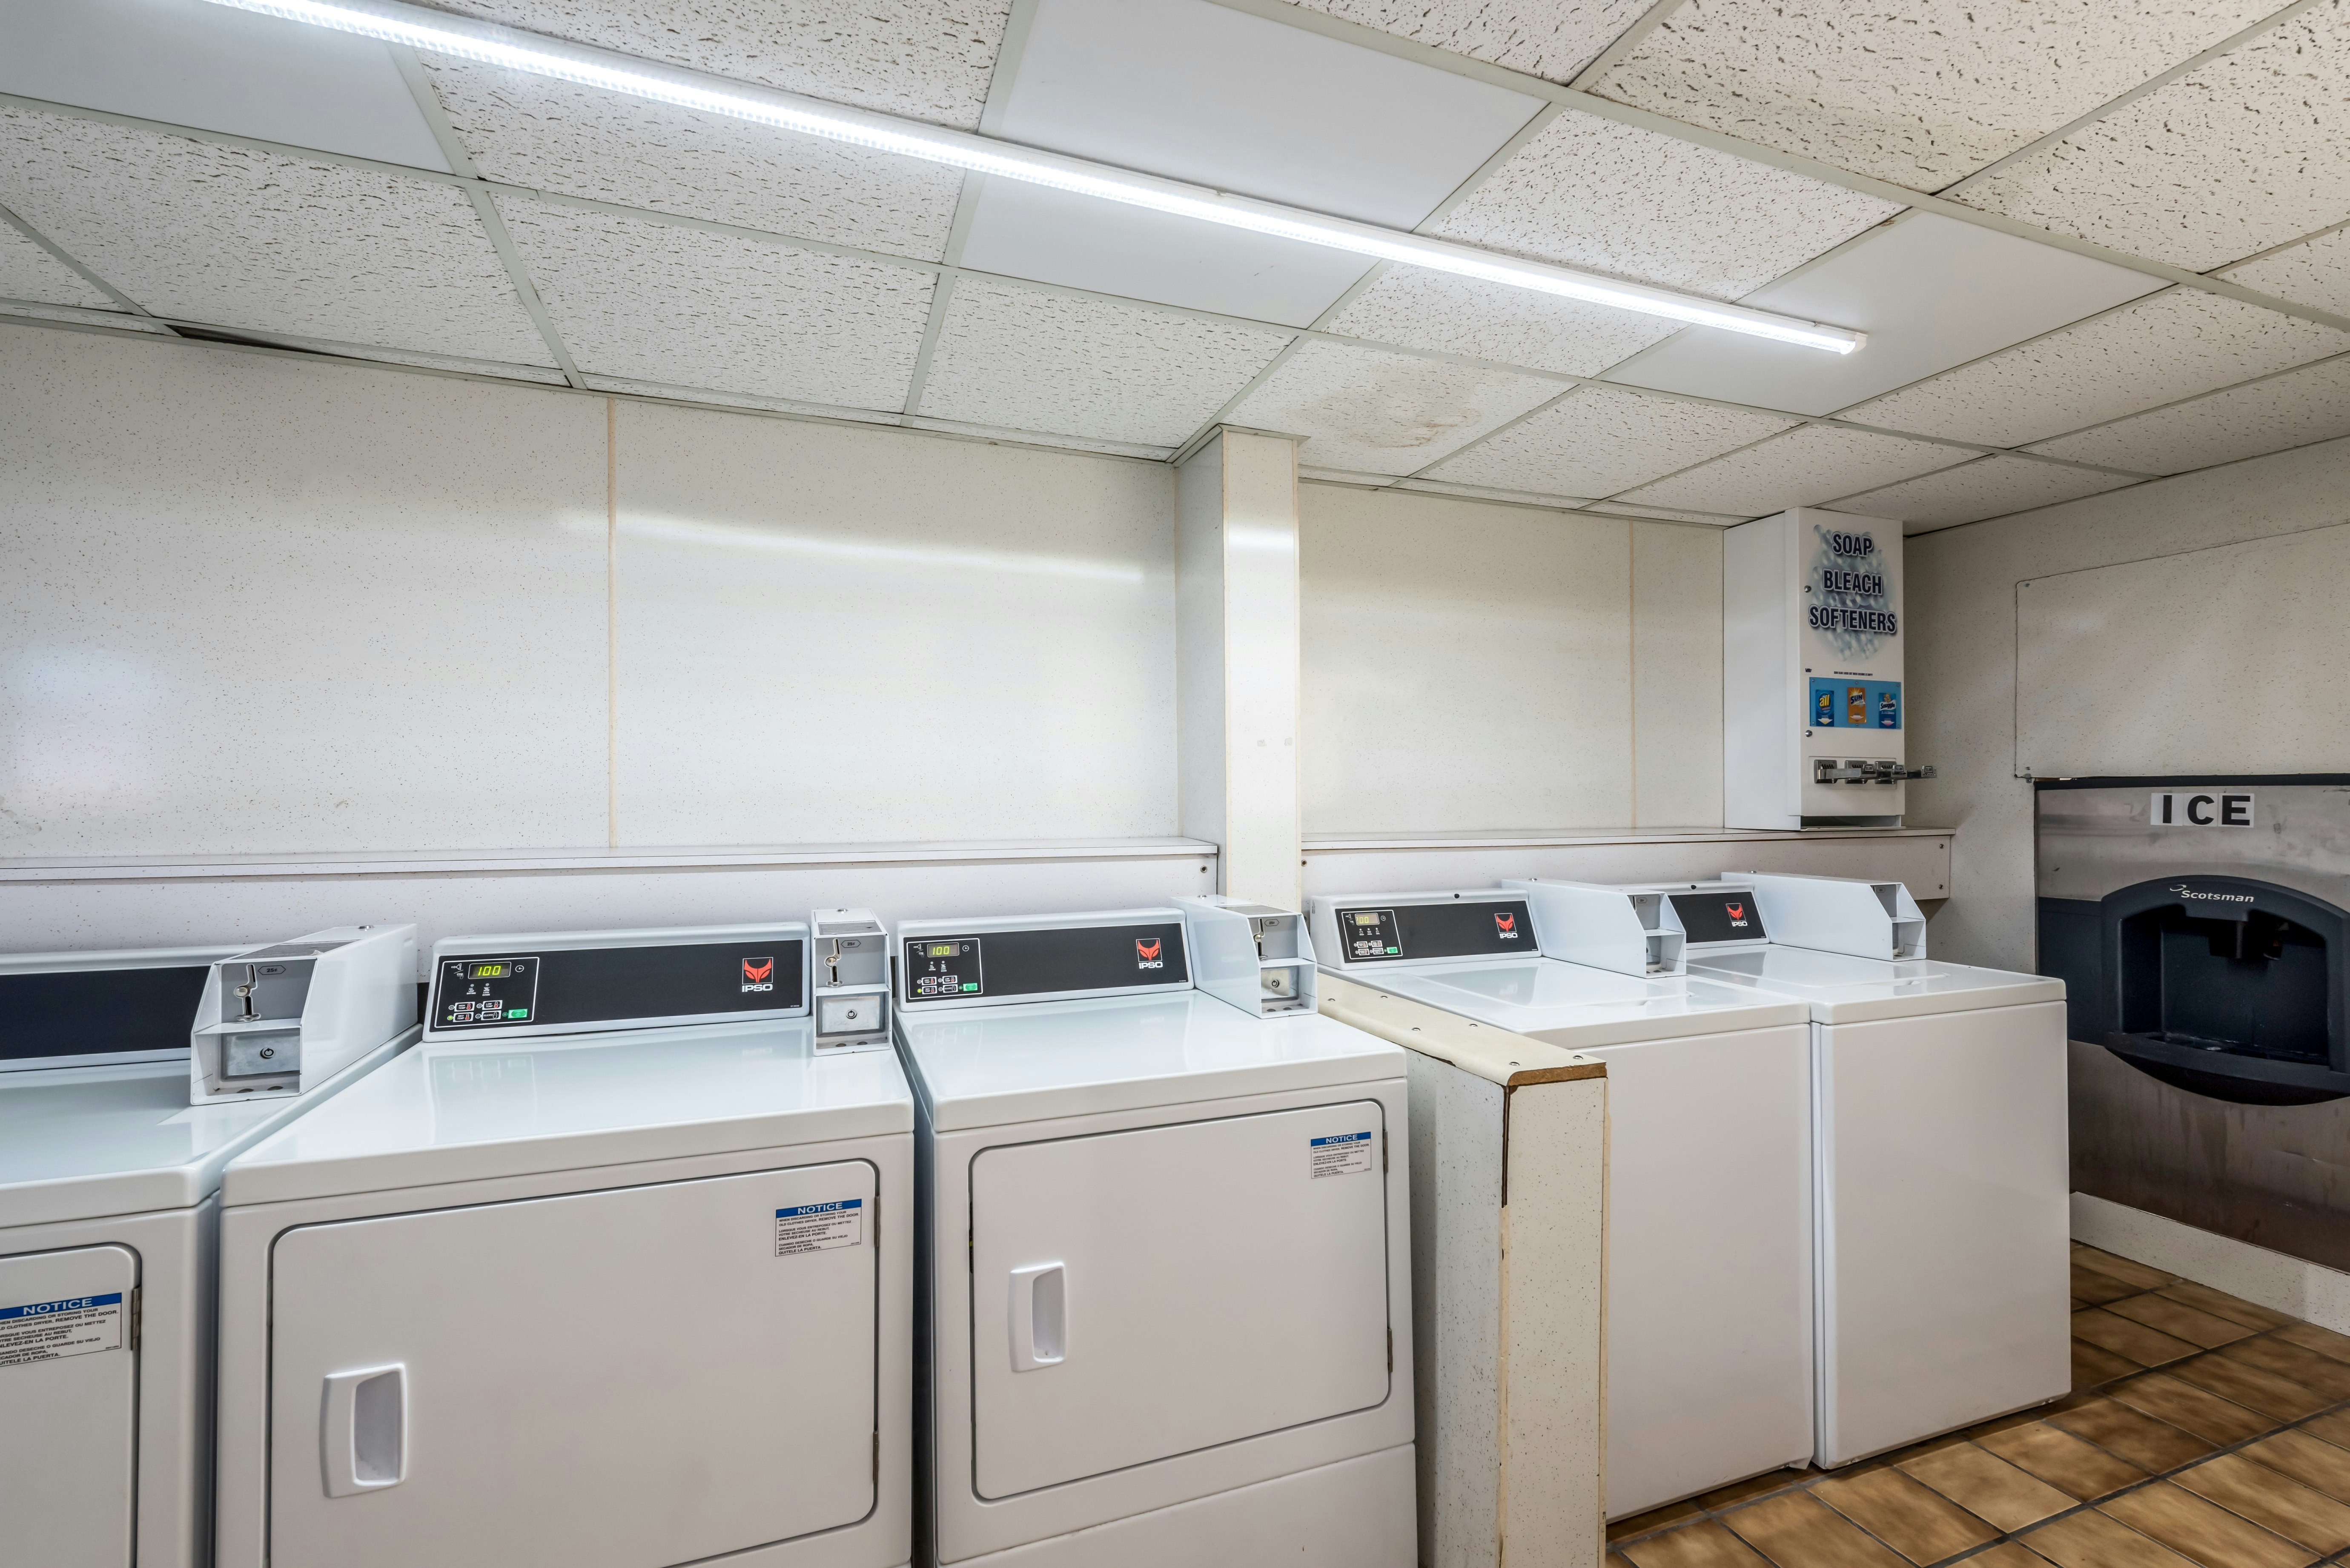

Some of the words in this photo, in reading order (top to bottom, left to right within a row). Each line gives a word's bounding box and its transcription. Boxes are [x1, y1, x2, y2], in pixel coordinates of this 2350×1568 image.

[1832, 532, 1873, 557] SOAP
[1823, 568, 1883, 595] BLEACH
[1809, 604, 1896, 633] SOFTENERS
[1819, 694, 1830, 707] all
[1850, 694, 1863, 705] SUN
[2163, 795, 2250, 826] ICE
[2181, 890, 2254, 902] Scotsman
[933, 946, 949, 955] 100
[478, 966, 501, 976] 100
[742, 984, 773, 992] IPSO
[1326, 1134, 1358, 1144] NOTICE
[798, 1202, 843, 1214] NOTICE
[23, 1298, 92, 1315] NOTICE
[38, 1325, 74, 1333] ENTREPOSEZ
